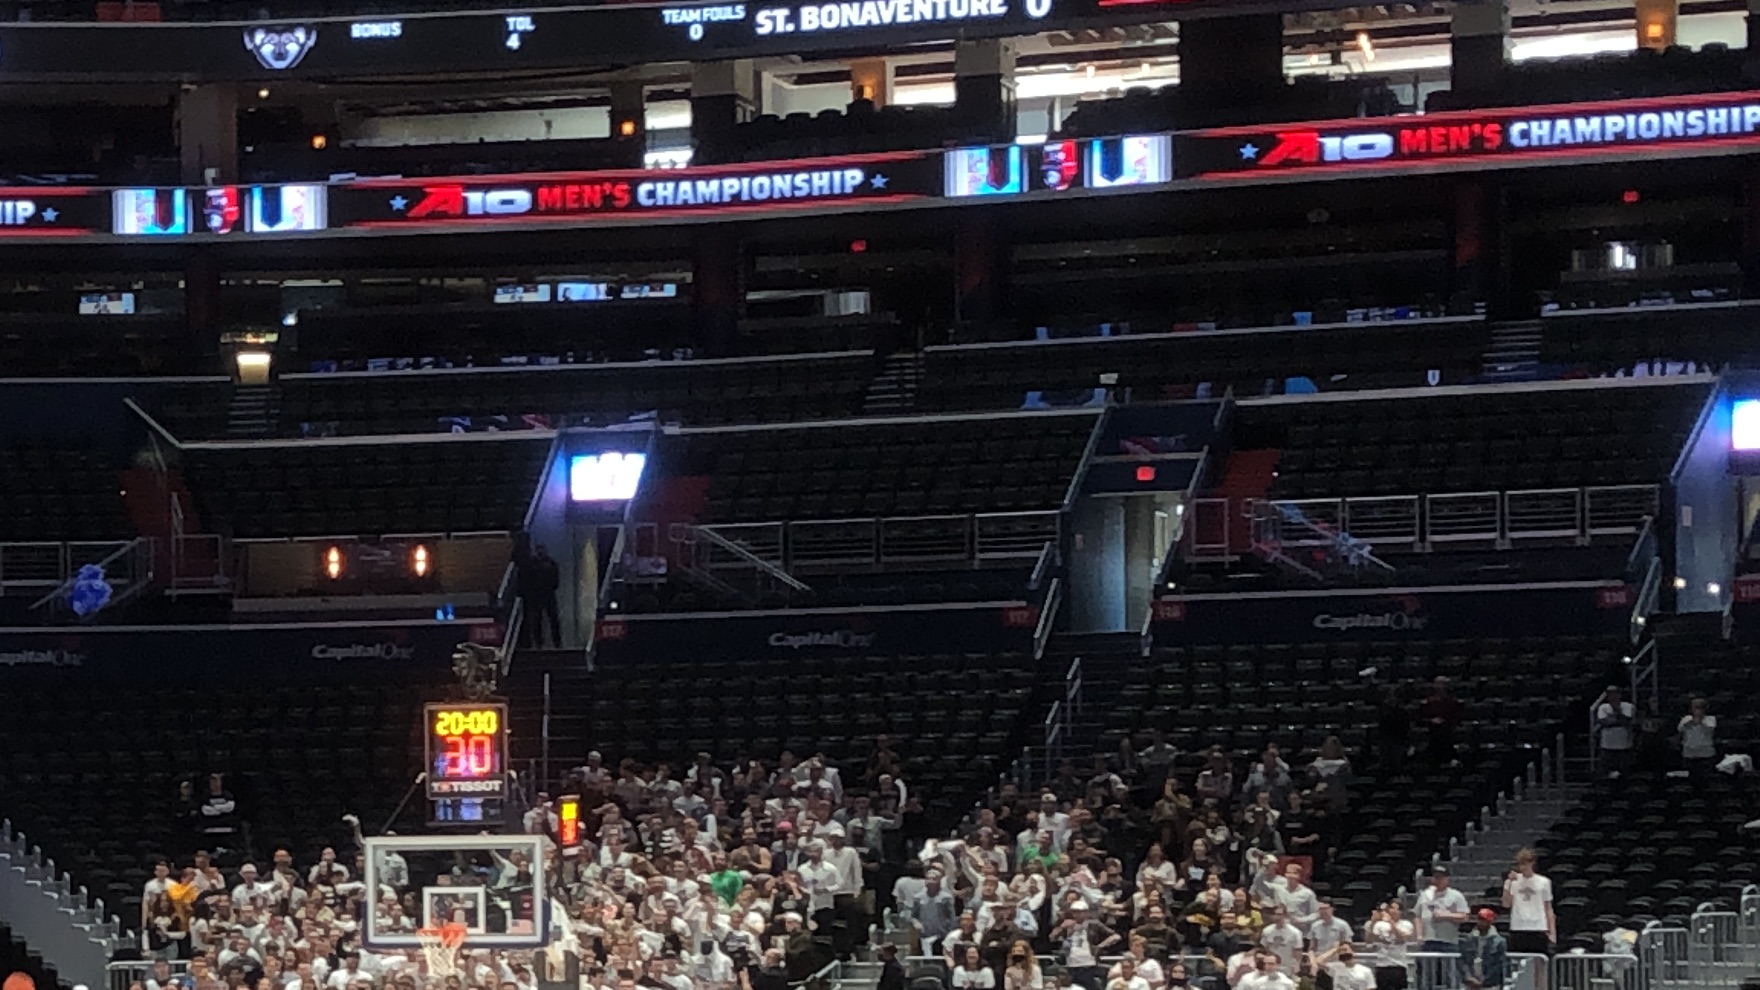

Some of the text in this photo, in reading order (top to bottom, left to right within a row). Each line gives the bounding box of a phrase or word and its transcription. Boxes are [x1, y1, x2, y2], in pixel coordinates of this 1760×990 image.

[662, 4, 746, 25] TEAM FOULS
[755, 9, 796, 35] ST.
[800, 0, 1009, 31] BONAVENTURE
[350, 22, 403, 38] BONUS
[506, 33, 521, 50] 4
[1259, 105, 1760, 165] A10 MEN'S CHAMPIONSHIP
[408, 168, 864, 217] A10 MEN'S CHAMPIONSHIP
[435, 711, 498, 736] 20:00
[444, 735, 491, 777] 30
[452, 780, 503, 792] TISSOT
